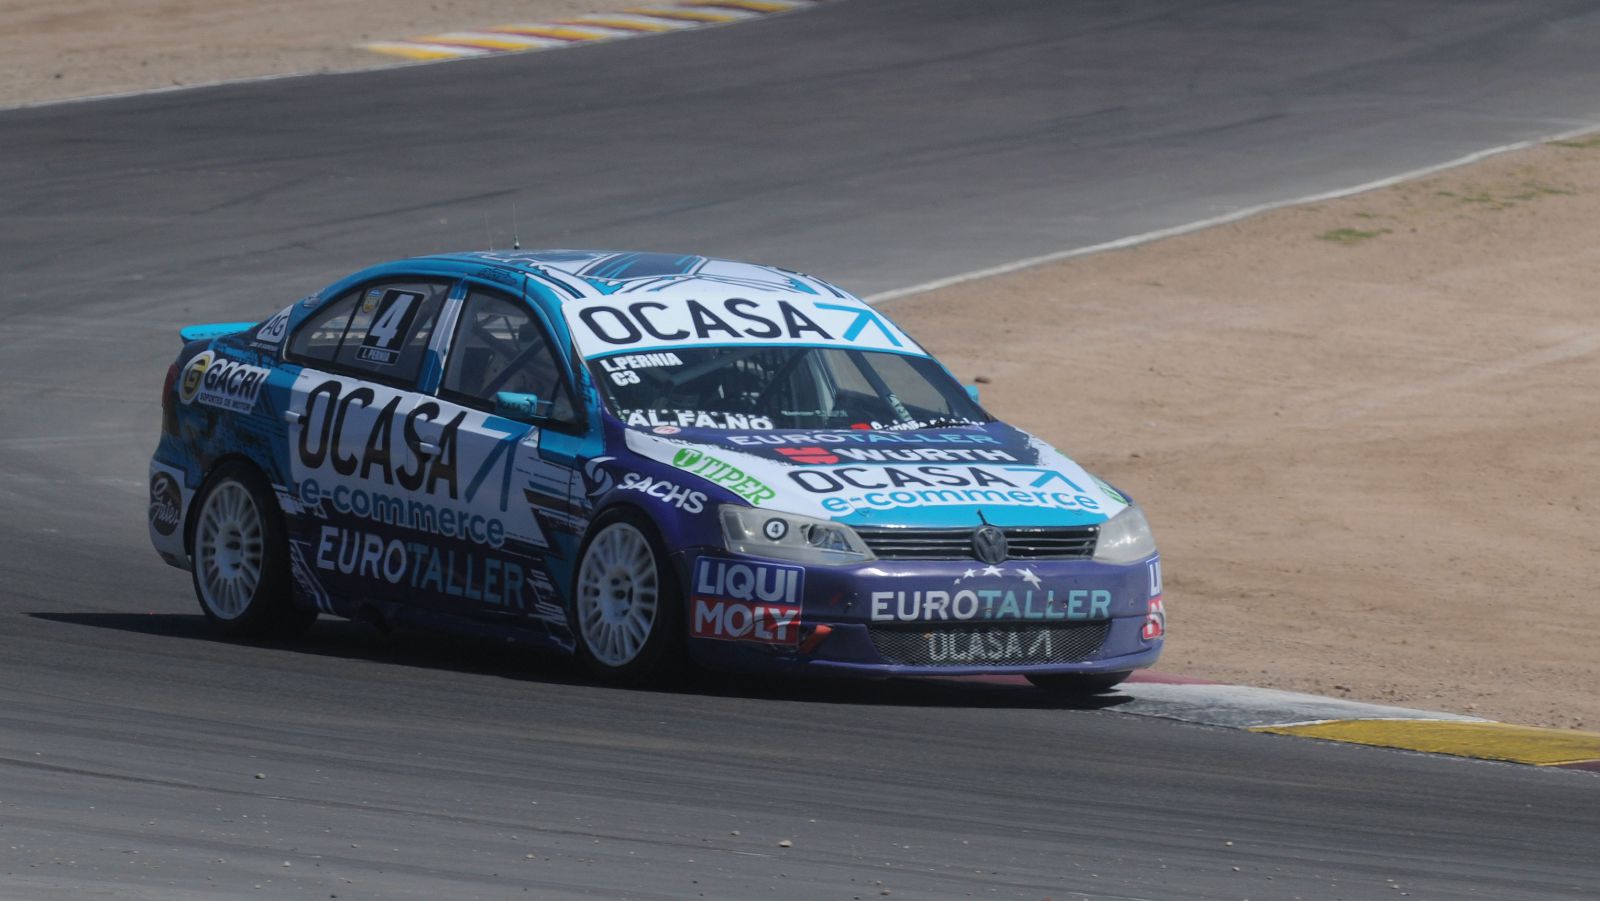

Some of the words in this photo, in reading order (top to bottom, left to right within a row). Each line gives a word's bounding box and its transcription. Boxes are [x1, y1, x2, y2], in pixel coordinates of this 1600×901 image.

[261, 314, 288, 338] AG
[370, 293, 416, 348] 4
[579, 297, 836, 346] OCASA
[204, 362, 264, 401] GACRI
[599, 352, 684, 373] L.PERNIA
[610, 370, 641, 387] C3
[298, 379, 468, 500] OCASA
[727, 433, 1002, 446] EUROTALLER
[617, 472, 709, 514] SACHS
[692, 456, 776, 506] TIPER
[788, 465, 1019, 494] OCASA
[821, 487, 1100, 512] e-commerce
[301, 477, 505, 547] e-commerce
[316, 525, 526, 609] EUROTALLER
[697, 560, 799, 603] LIQUI
[694, 599, 800, 641] MOLY
[870, 589, 1113, 622] EUROTALLER
[928, 629, 1023, 661] OCASA
